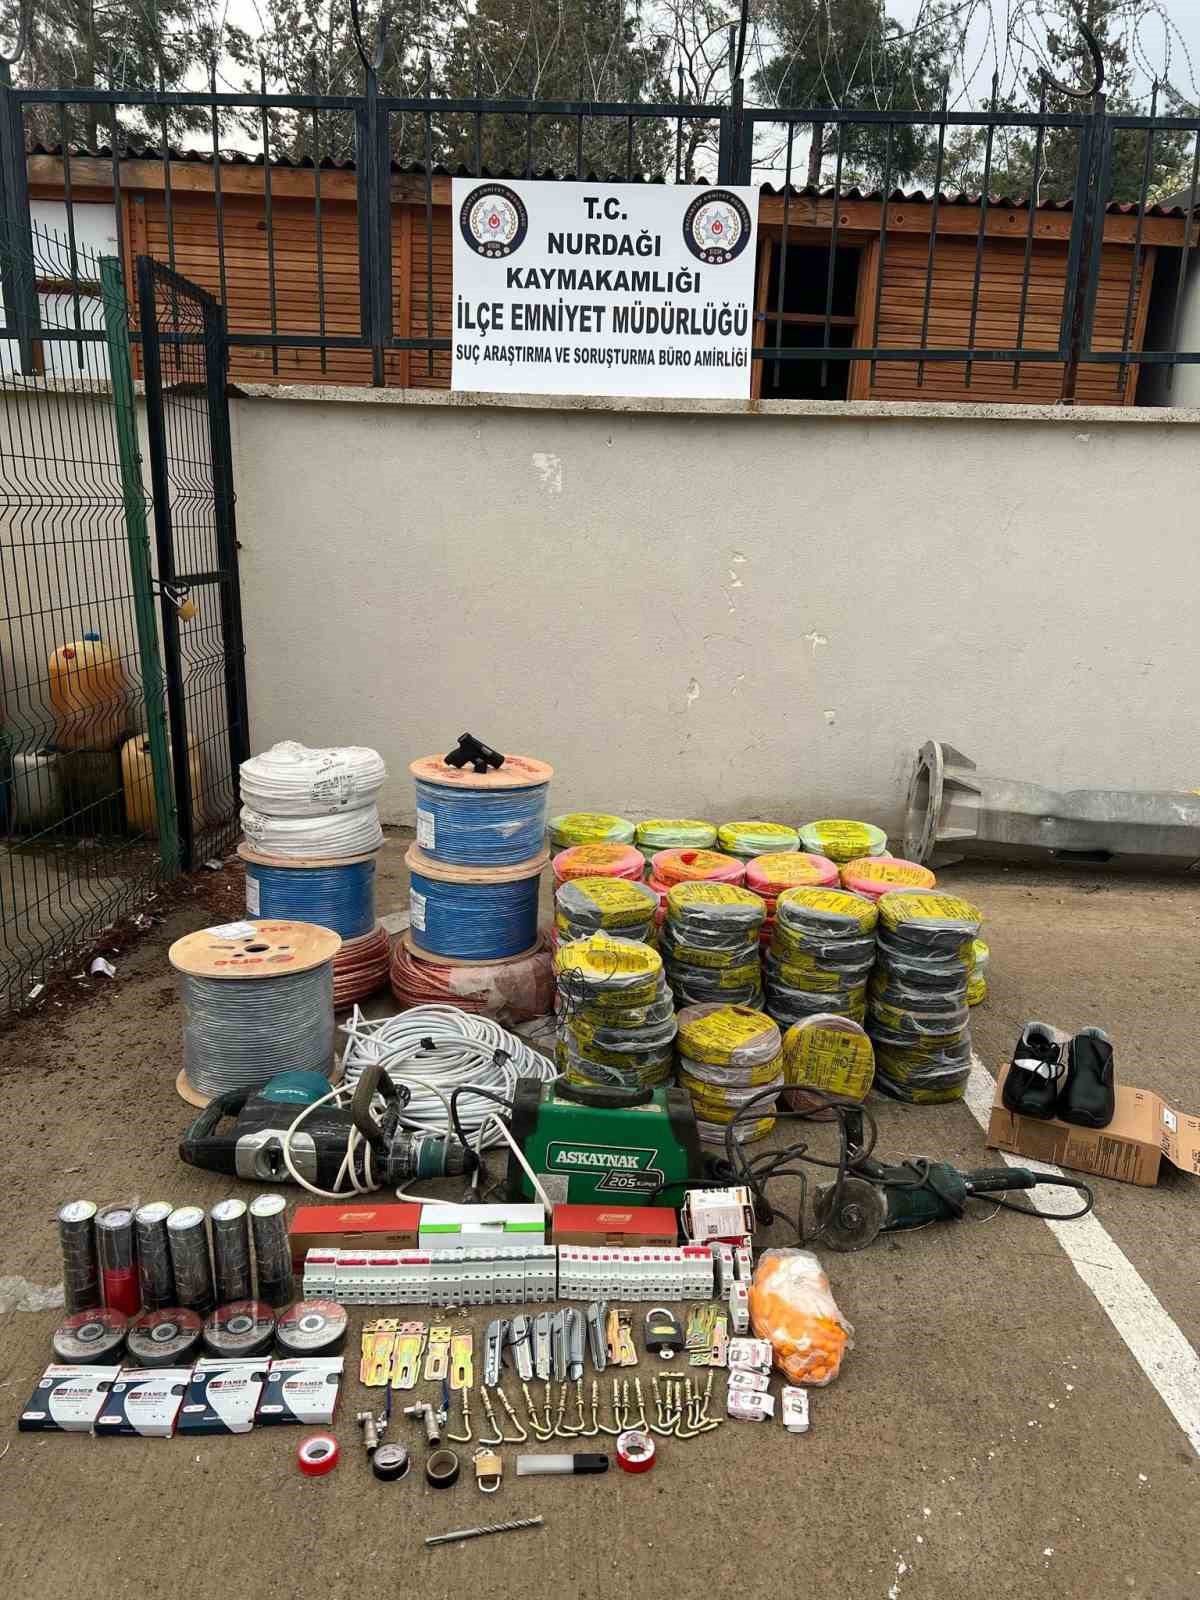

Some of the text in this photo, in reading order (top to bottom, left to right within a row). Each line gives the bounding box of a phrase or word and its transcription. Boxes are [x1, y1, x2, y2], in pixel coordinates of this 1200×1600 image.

[584, 197, 627, 220] T.C.
[548, 229, 661, 257] NURDAĞI
[507, 266, 701, 293] KAYMAKAMLIĞI
[457, 294, 748, 337] İLÇE EMNİYET MÜDÜRLÜĞÜ
[456, 344, 748, 368] SUÇ ARAŞTIRMA VE SORUŞTURMA BÜRO AMİRLİĞİ
[555, 1150, 640, 1169] ASKAYNAK
[609, 1177, 637, 1188] 205
